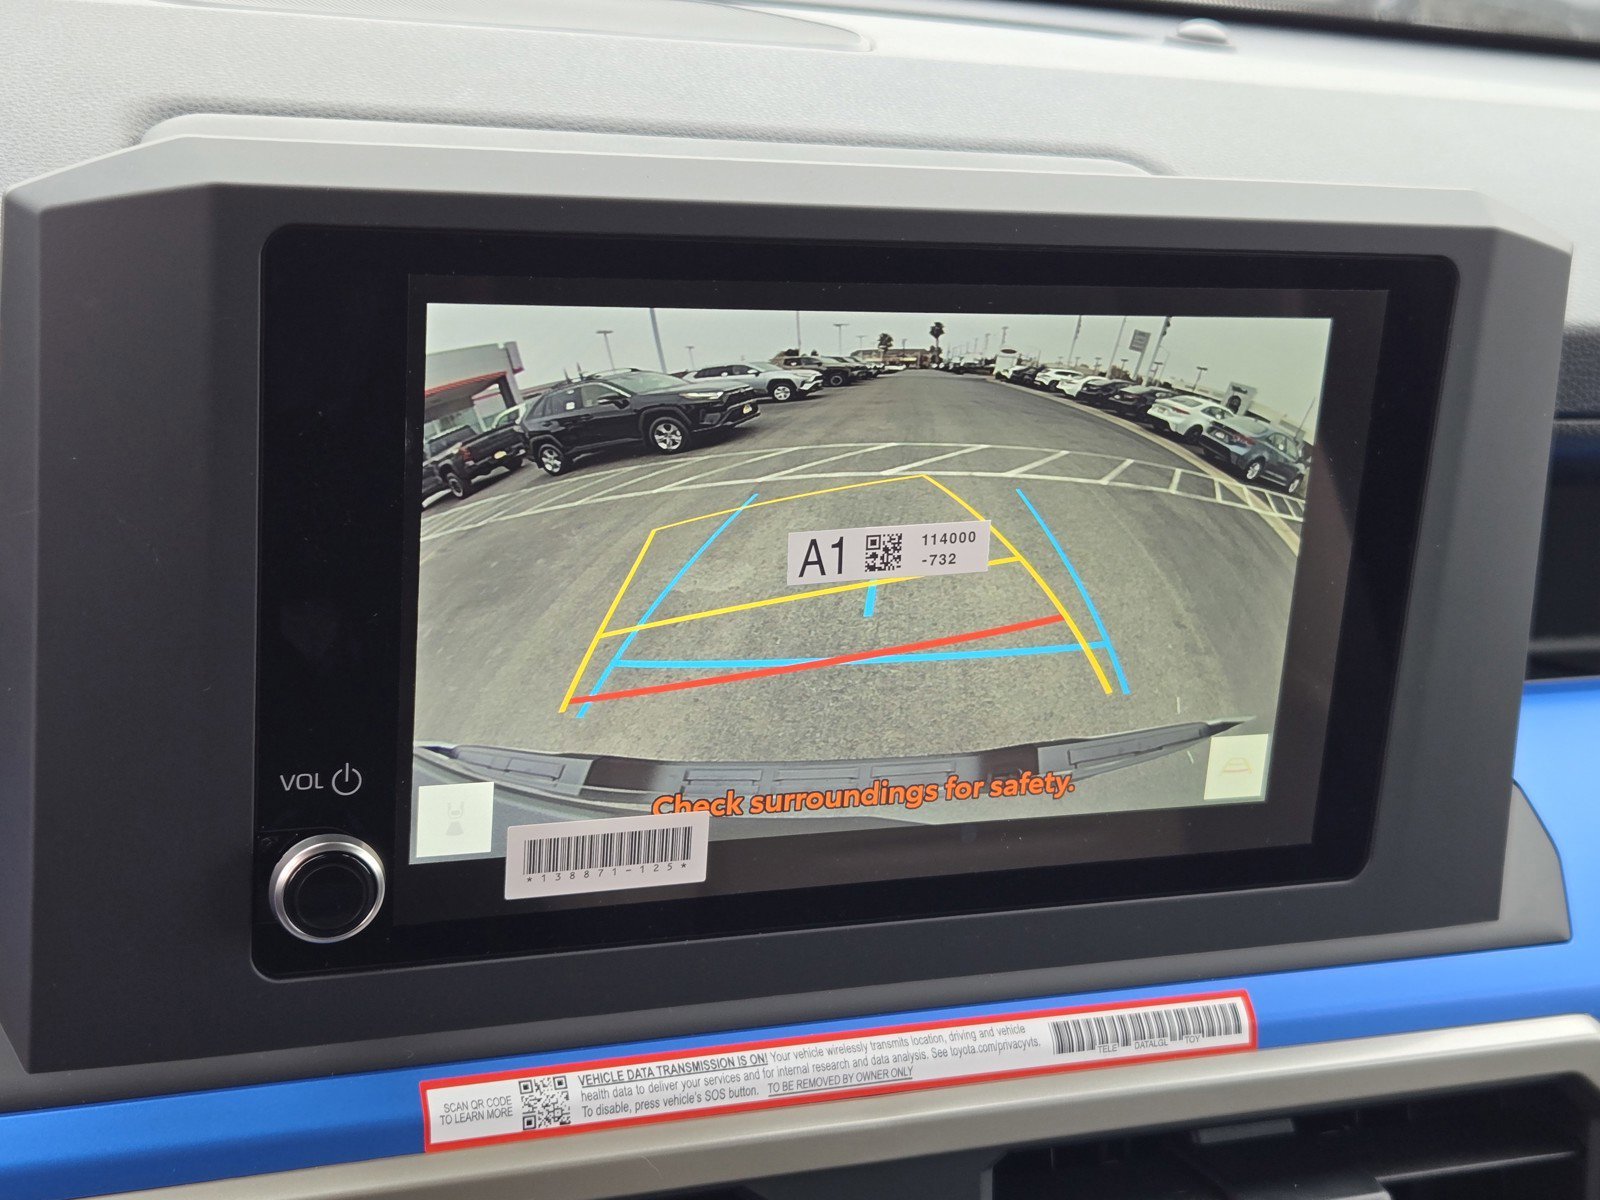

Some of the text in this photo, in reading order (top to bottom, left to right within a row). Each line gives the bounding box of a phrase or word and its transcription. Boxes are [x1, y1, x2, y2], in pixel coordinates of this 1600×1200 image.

[921, 531, 977, 546] 114000
[798, 536, 845, 578] A1
[921, 553, 957, 567] -732
[280, 773, 324, 791] VOL
[651, 770, 1076, 817] Check surroundings for safety.
[1098, 1042, 1118, 1054] TELE
[1184, 1034, 1201, 1044] TOY
[578, 1023, 1026, 1087] VEHICLE DATA TRANSMISSION IS ON! Your vehicle wirelessly transmits location, driving and vehicle
[580, 1037, 1041, 1101] health data to deliver your services and for internal research and data analysis. See toyota.com/privacyvts.
[582, 1066, 913, 1118] To disable, press vehicle's SOS button. TO BE REMOVED BY OWNER ONLY
[443, 1096, 512, 1113] SCAN QR CODE
[440, 1107, 513, 1125] TO LEARN MORE
